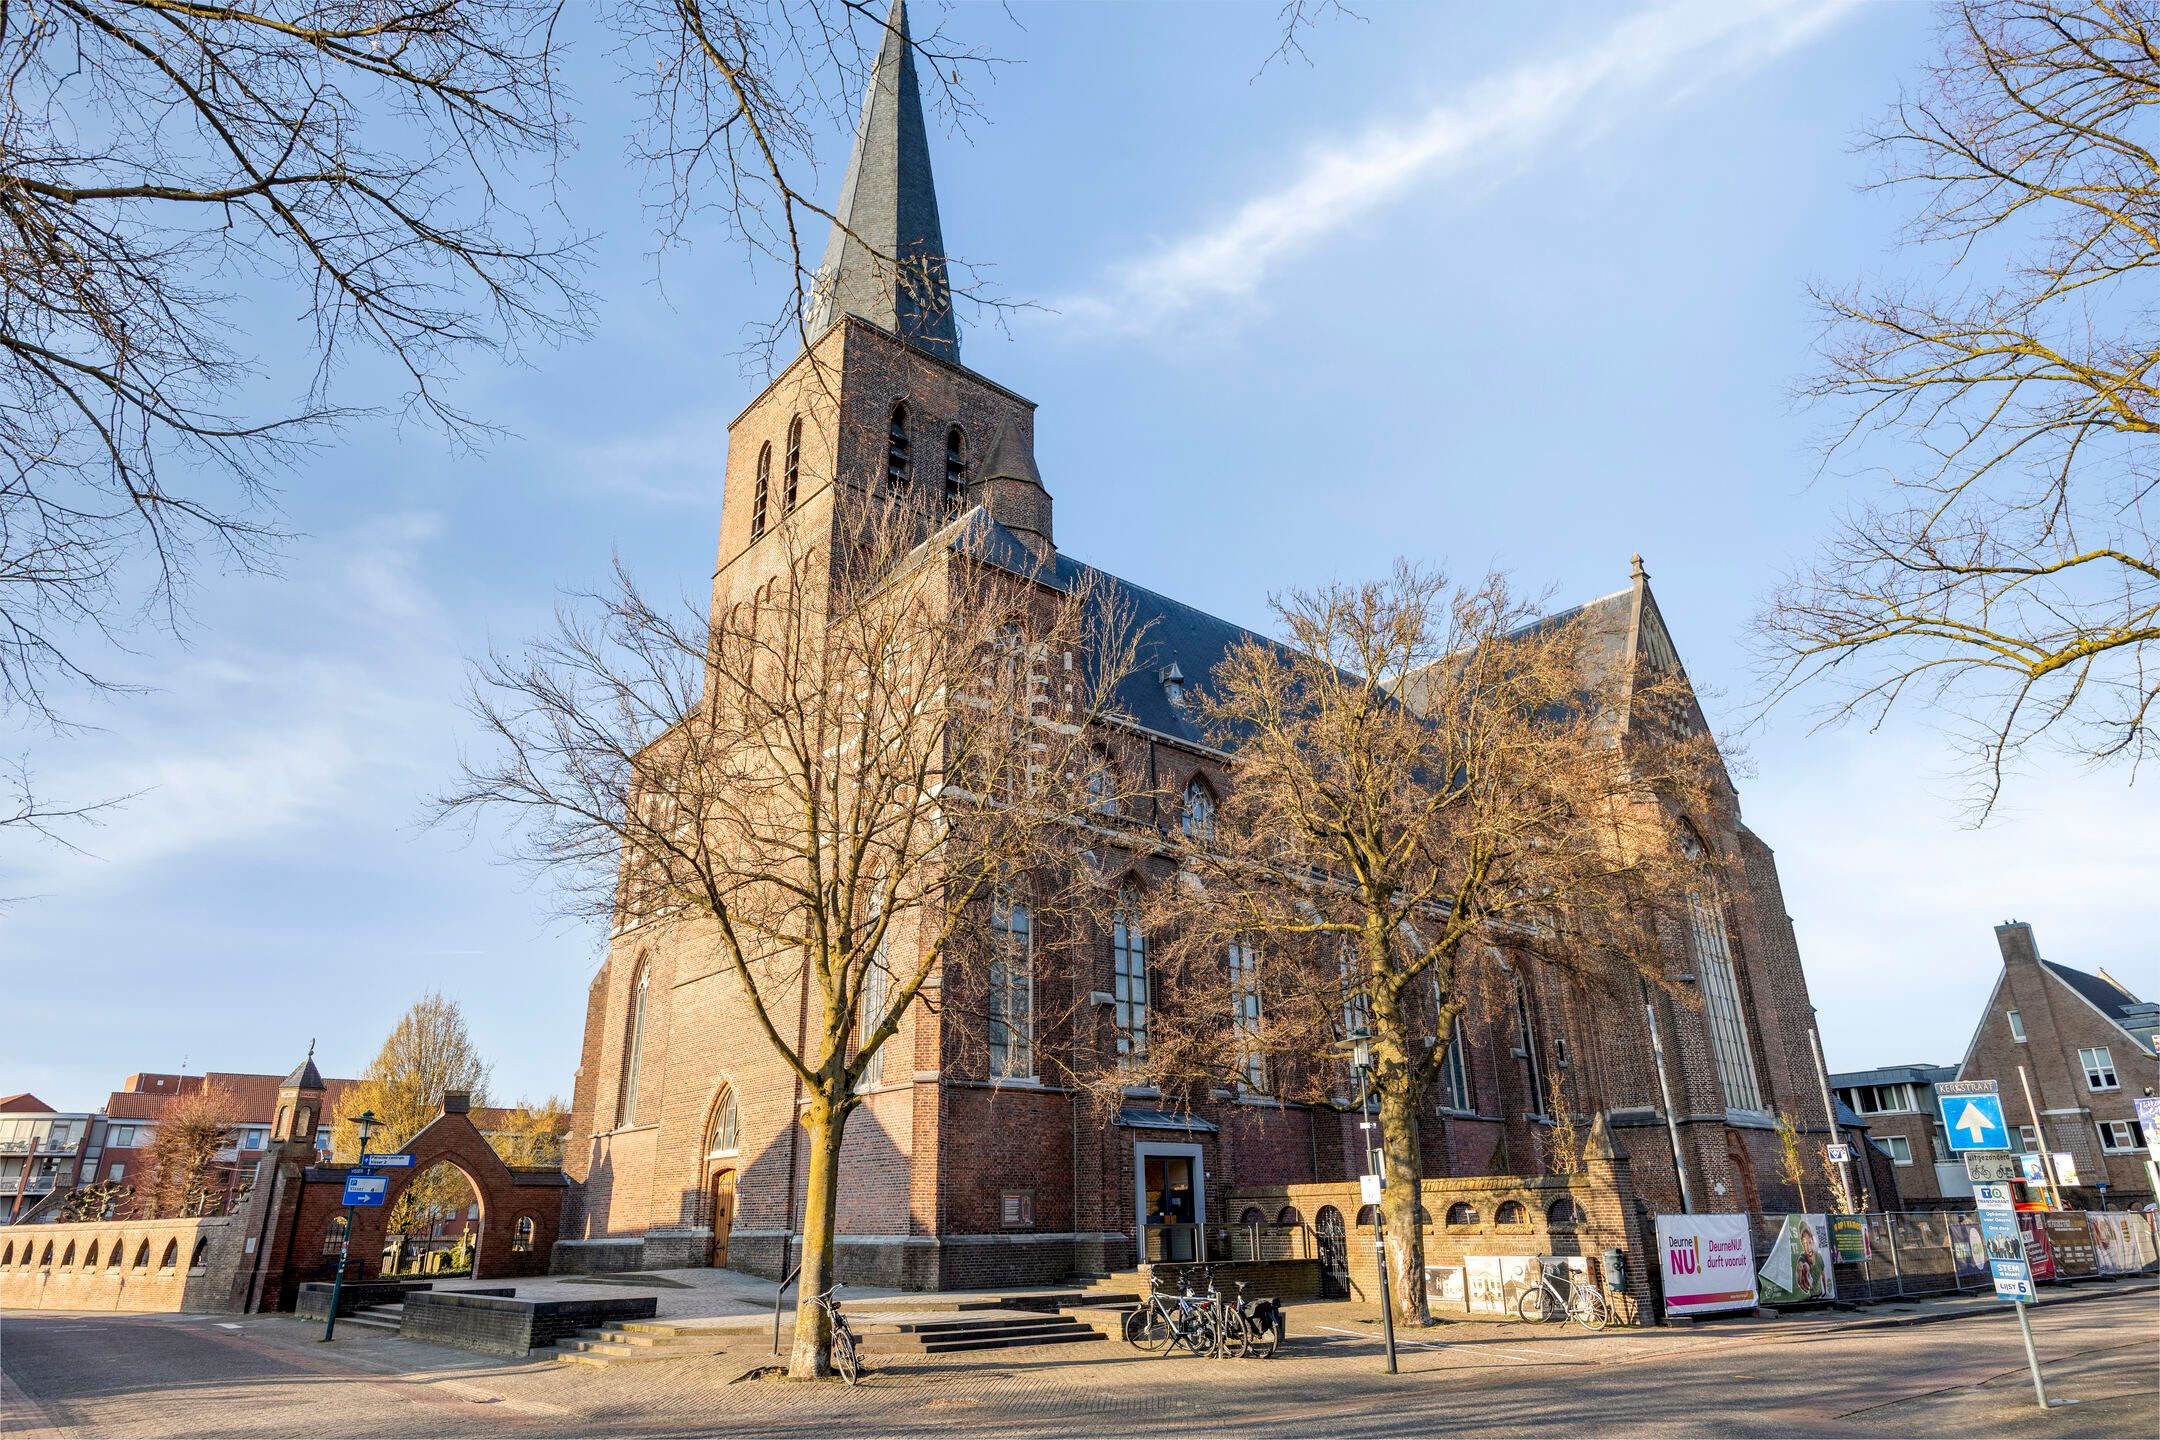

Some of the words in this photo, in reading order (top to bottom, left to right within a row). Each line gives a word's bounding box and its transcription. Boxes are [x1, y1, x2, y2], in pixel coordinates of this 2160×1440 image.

[1940, 1083, 1993, 1093] KERKSTRAAT
[1967, 1154, 2010, 1162] uitgezonderd
[1669, 1236, 1693, 1247] Deurne
[1708, 1239, 1742, 1252] DeurneNU!
[1670, 1236, 1702, 1275] NU!
[1707, 1256, 1724, 1268] durft
[1725, 1255, 1747, 1267] vooruit
[1997, 1264, 2020, 1272] STEM
[2018, 1282, 2027, 1293] 6
